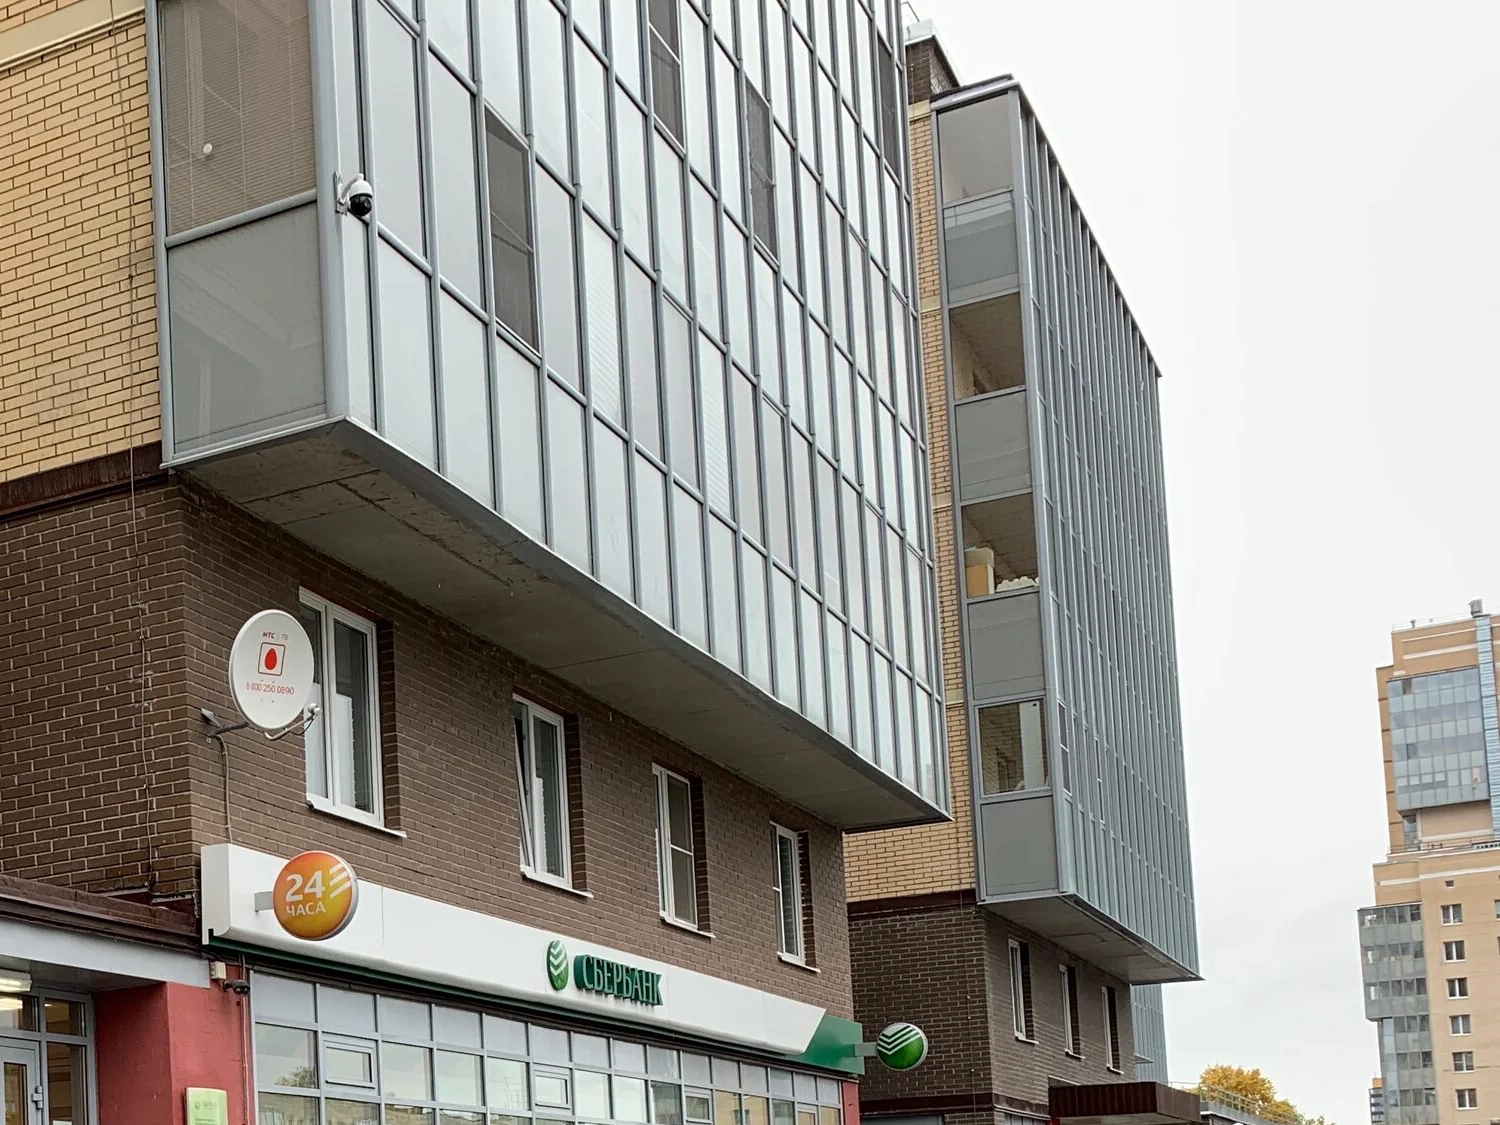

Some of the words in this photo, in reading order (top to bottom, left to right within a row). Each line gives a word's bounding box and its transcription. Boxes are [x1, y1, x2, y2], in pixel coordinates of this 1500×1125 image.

[251, 682, 262, 692] 800
[263, 684, 276, 693] 250
[285, 870, 326, 902] 24
[285, 901, 327, 917] ЧАСА
[573, 954, 664, 1006] СБЕРБАНК
